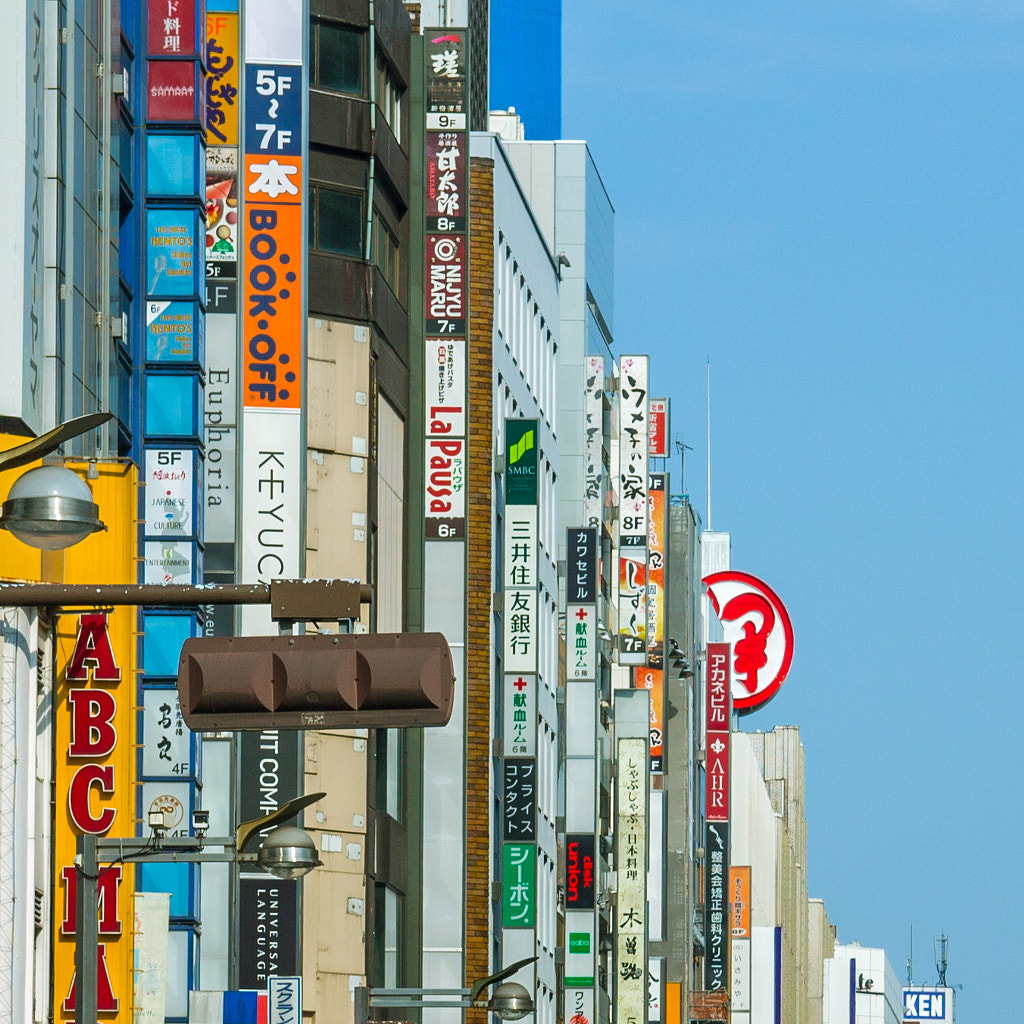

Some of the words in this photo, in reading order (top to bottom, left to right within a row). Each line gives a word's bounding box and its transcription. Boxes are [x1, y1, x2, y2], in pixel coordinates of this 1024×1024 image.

[151, 85, 195, 97] SAMRAT
[438, 115, 456, 128] 9F
[248, 159, 299, 199] 本
[437, 217, 455, 231] 8F
[430, 264, 446, 318] MARU
[446, 264, 461, 318] NIJYU
[150, 304, 161, 314] 6F
[437, 319, 455, 333] 7F
[204, 367, 231, 508] Euphoria
[157, 451, 182, 466] 5F
[508, 466, 535, 475] SMBC
[151, 497, 186, 507] JAPANESE
[257, 450, 285, 585] KEYUC
[623, 516, 644, 530] 8F
[153, 521, 183, 530] CULTURE
[438, 523, 456, 537] 6F
[626, 536, 641, 545] 7F
[575, 532, 588, 600] カワセビル
[510, 521, 531, 656] 三井住友銀行
[575, 623, 587, 668] 献血ルーム
[624, 639, 642, 652] 7F
[711, 654, 726, 723] アカネビル
[513, 693, 527, 743] 献血ルーム
[172, 763, 189, 775] 4F
[568, 842, 581, 901] union
[583, 856, 593, 888] disk
